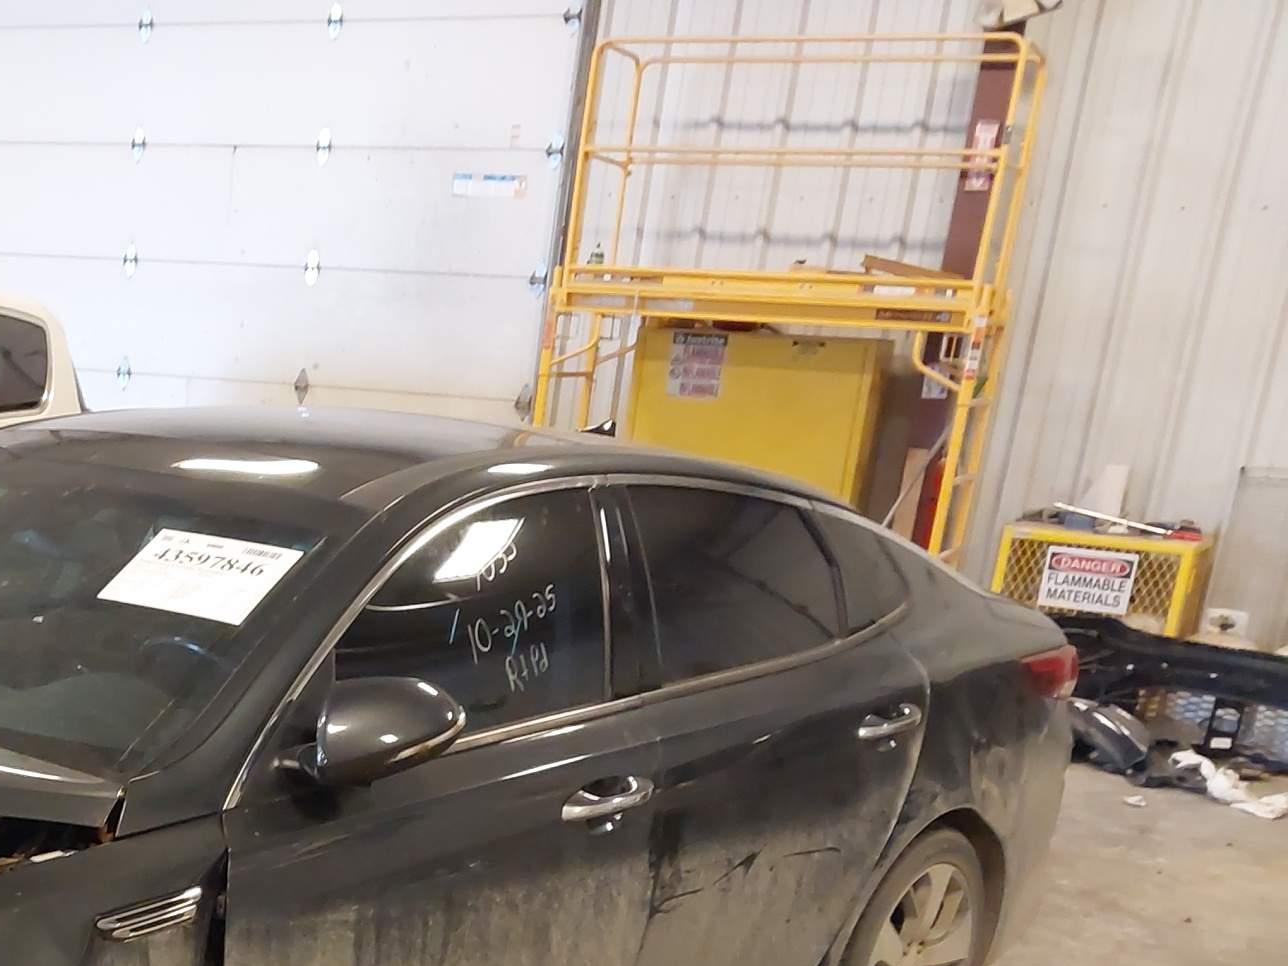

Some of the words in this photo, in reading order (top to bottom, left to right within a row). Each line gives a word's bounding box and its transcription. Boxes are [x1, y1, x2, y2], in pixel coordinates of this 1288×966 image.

[154, 547, 265, 577] 43597846
[1060, 557, 1121, 574] DANGER
[1047, 572, 1127, 593] FLAMMABLE
[1045, 587, 1121, 608] MATERIALS
